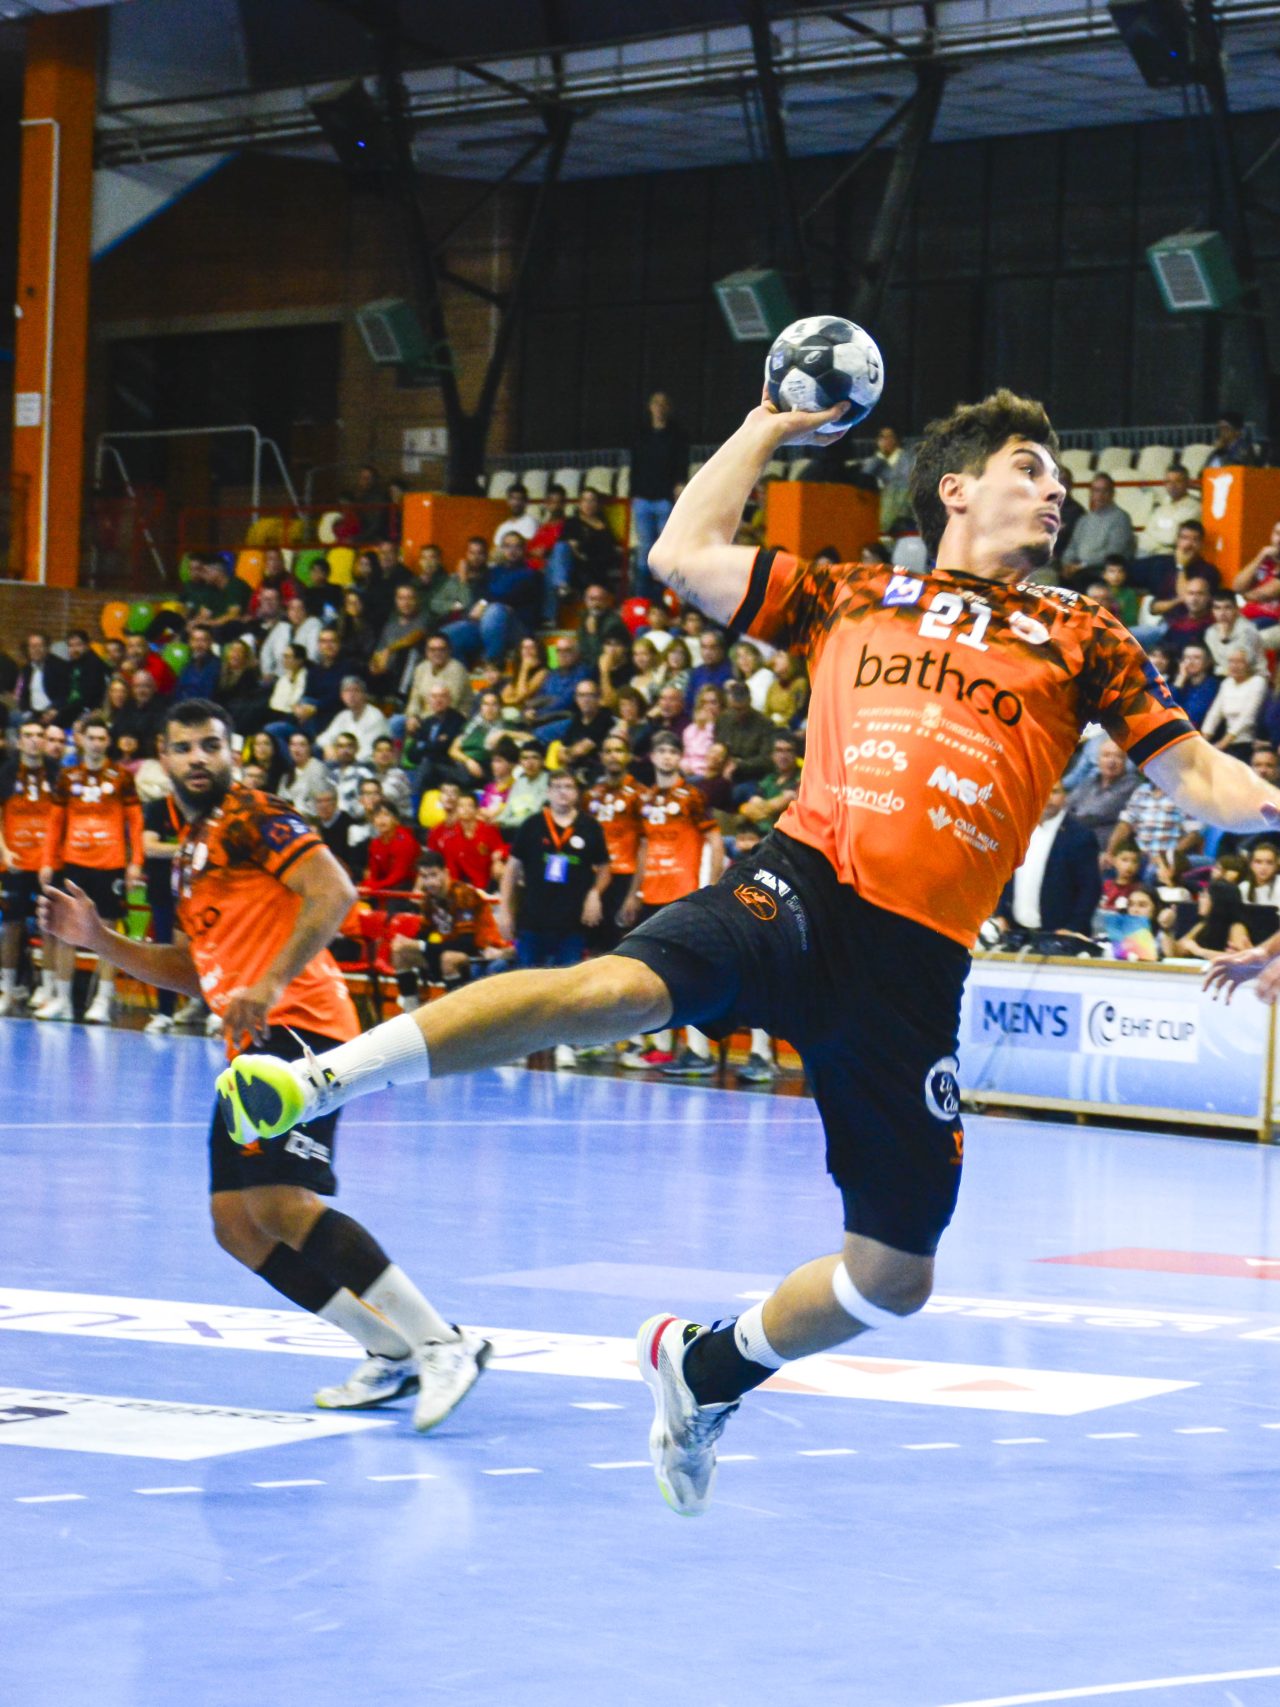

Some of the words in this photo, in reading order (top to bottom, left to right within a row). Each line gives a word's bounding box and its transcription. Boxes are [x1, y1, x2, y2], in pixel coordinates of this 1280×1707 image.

[918, 591, 994, 653] 21
[853, 643, 1023, 728] bathco
[983, 1000, 1068, 1037] MEN'S
[1120, 1016, 1151, 1037] EHF
[1156, 1018, 1196, 1043] CUP
